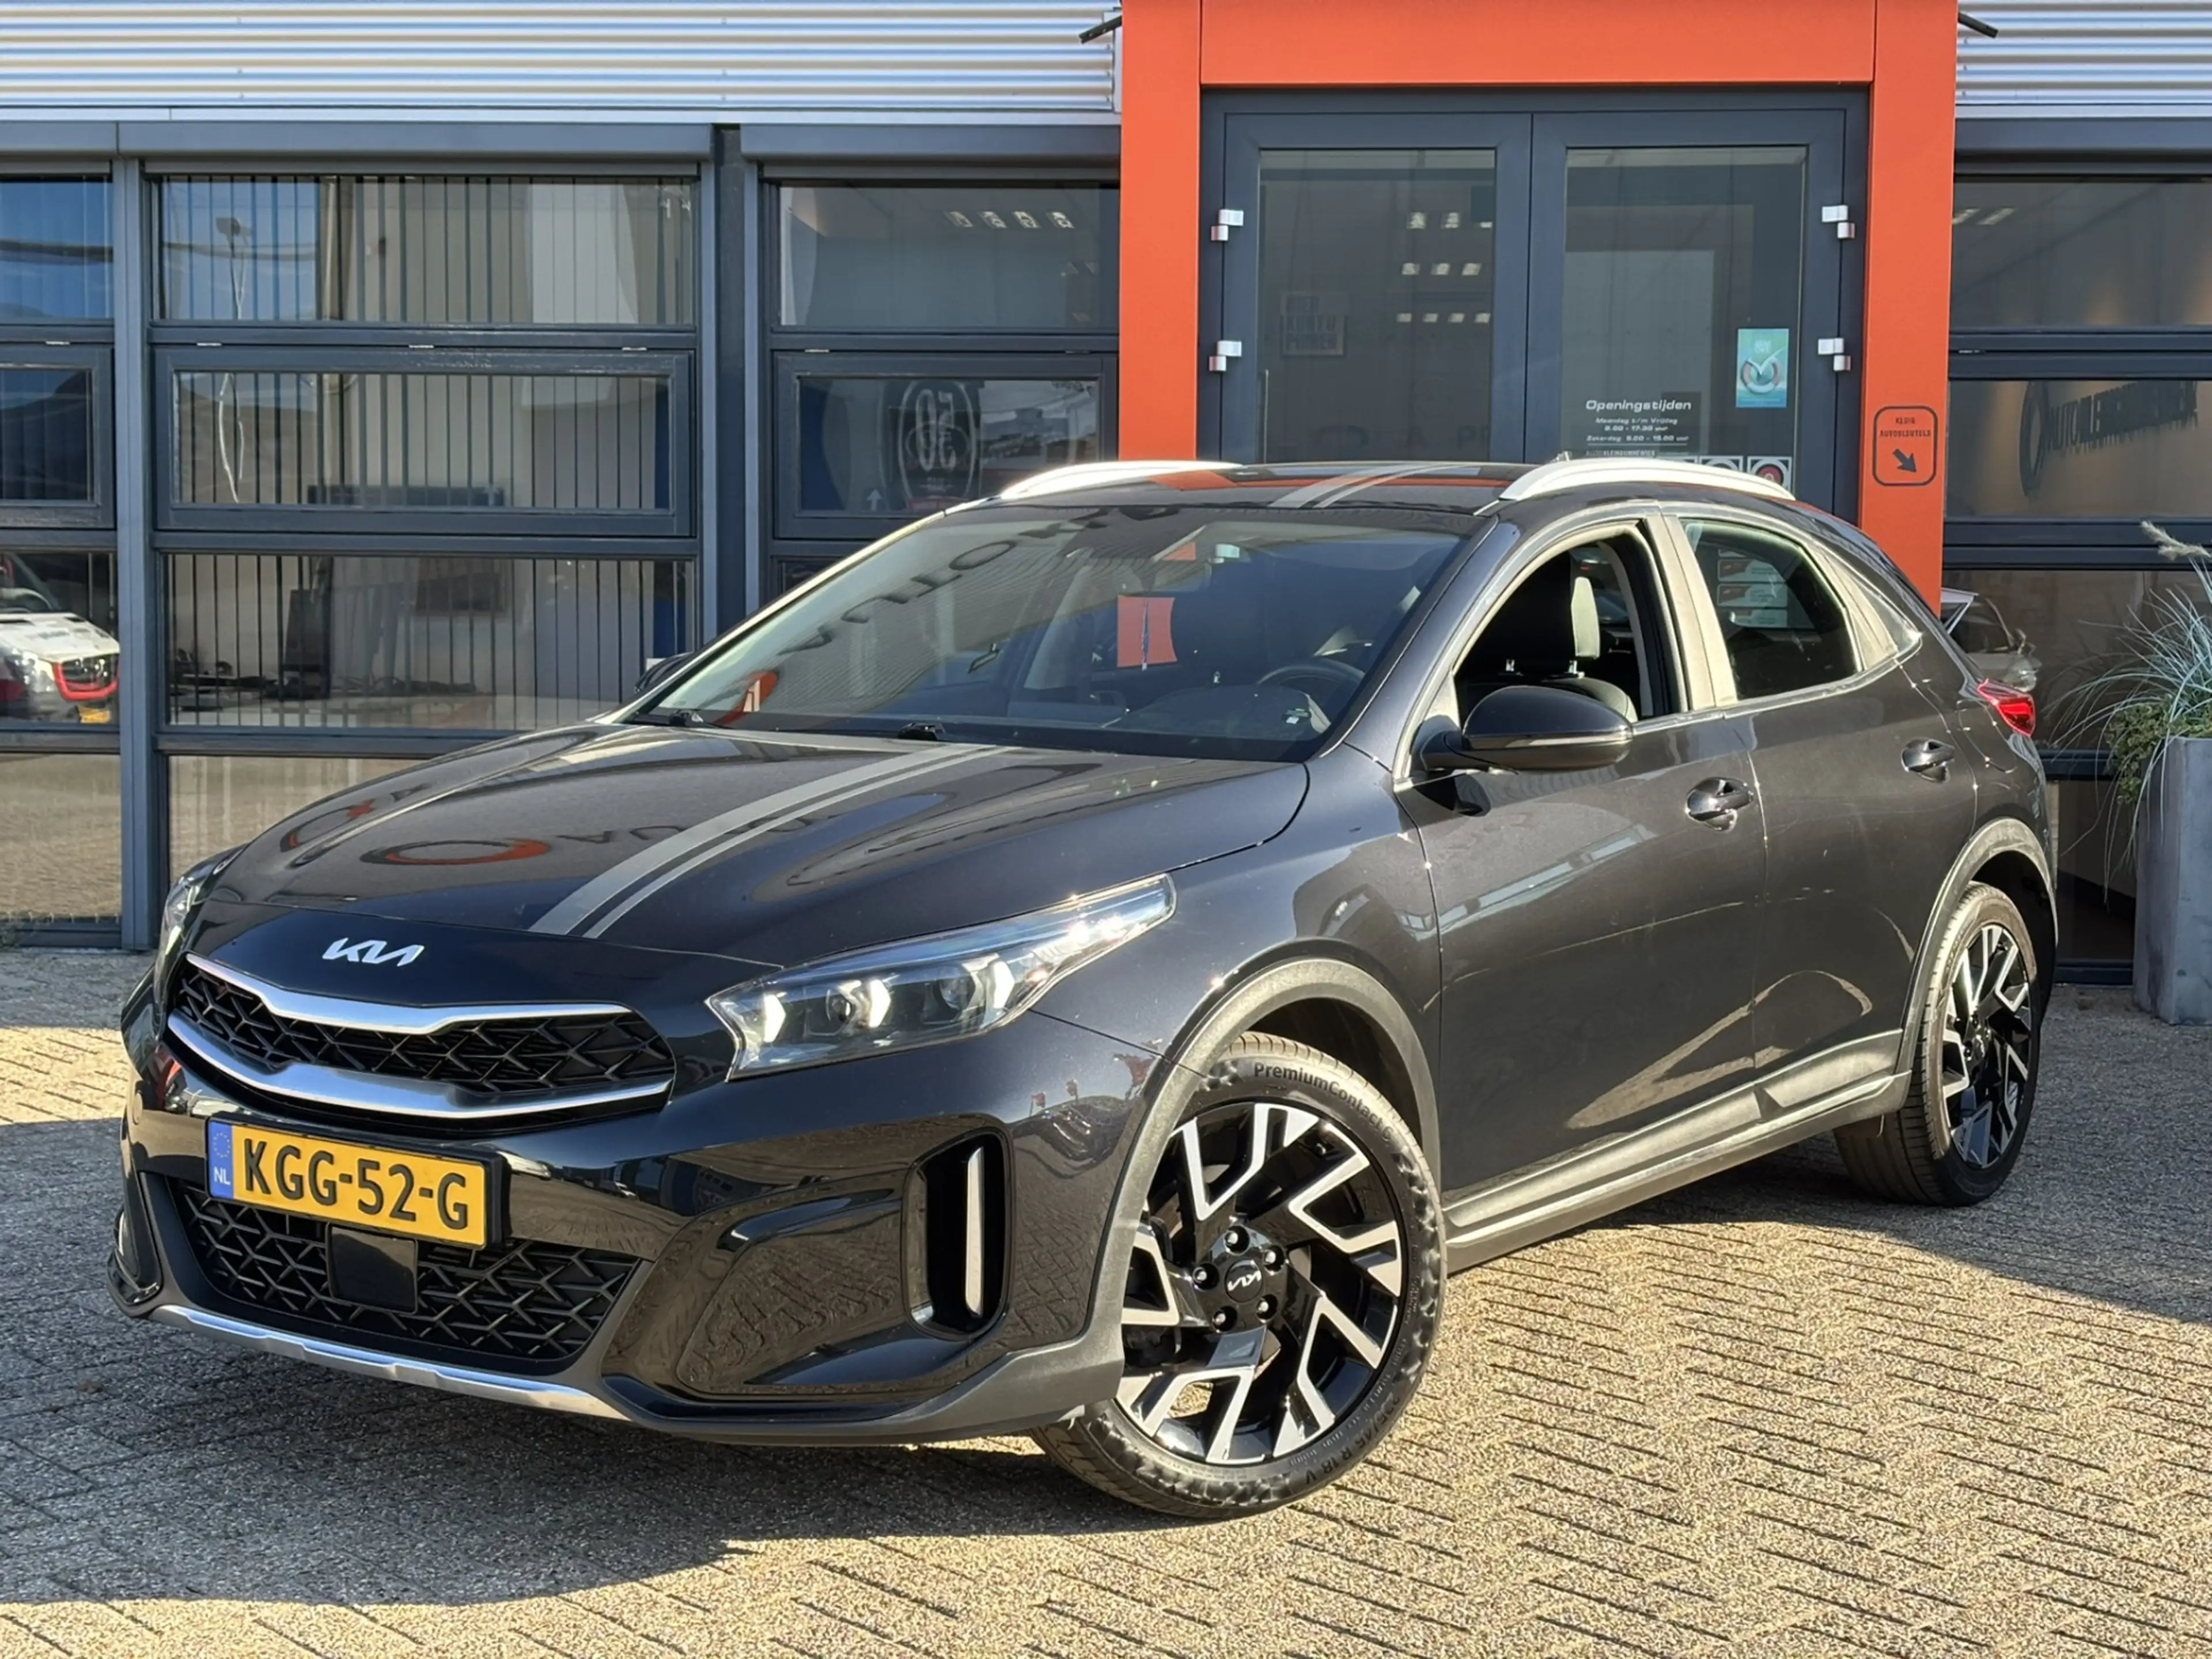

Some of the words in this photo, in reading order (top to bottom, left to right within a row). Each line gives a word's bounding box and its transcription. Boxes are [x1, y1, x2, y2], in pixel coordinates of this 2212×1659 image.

[1585, 399, 1692, 413] Openingstijden
[1651, 417, 1678, 426] Vrijdag
[321, 937, 425, 967] KIA
[1253, 1062, 1384, 1130] PremiumContact
[213, 1166, 231, 1185] NL
[244, 1138, 468, 1230] KGG-52-G
